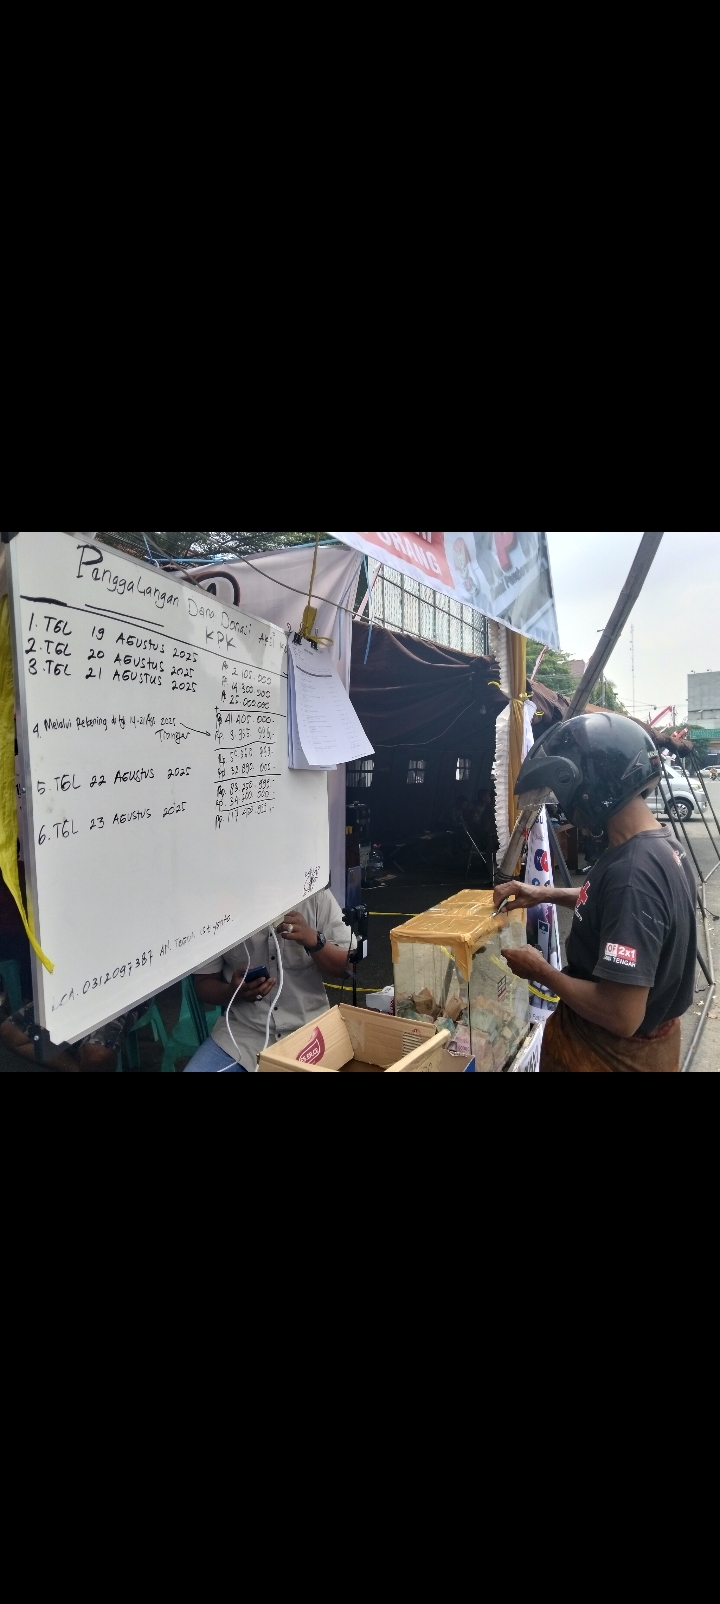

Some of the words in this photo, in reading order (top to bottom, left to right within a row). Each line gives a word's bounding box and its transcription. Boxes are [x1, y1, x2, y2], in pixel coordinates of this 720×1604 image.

[44, 615, 72, 636] TGL
[91, 626, 105, 640] 19
[172, 648, 198, 663] 2025
[205, 625, 237, 651] KPK
[44, 639, 72, 657] TGL
[87, 648, 105, 661] 20
[170, 666, 195, 679] 2025
[45, 659, 72, 677] TGL
[85, 667, 102, 681] 21
[171, 681, 198, 693] 2025
[54, 773, 81, 792] TGL
[89, 775, 107, 788] 22
[167, 766, 192, 780] 2025
[53, 818, 79, 839] TGL
[89, 817, 105, 831] 23
[162, 801, 188, 818] 2025
[618, 946, 636, 959] 2x1
[82, 950, 154, 995] 0312097387
